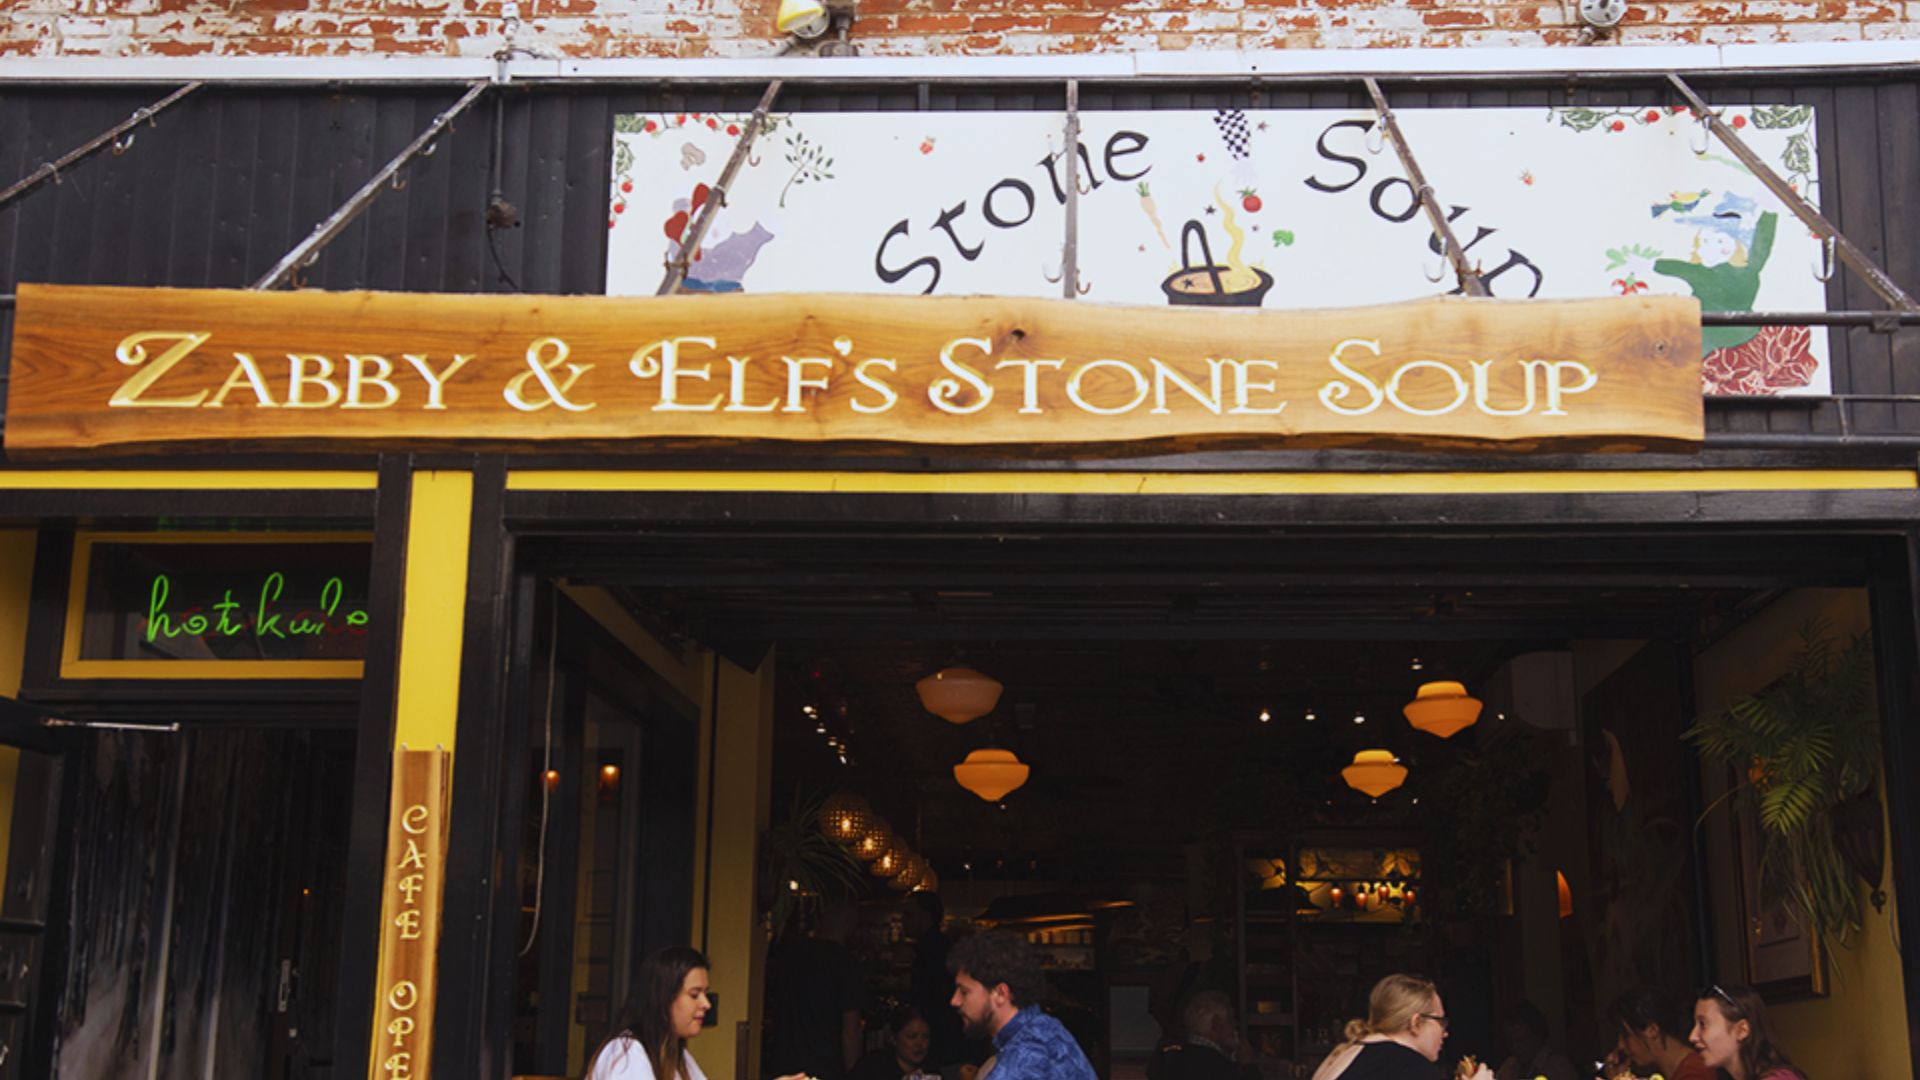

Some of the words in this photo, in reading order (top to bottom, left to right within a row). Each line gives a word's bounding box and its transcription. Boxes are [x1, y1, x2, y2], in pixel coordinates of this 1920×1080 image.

[875, 130, 1152, 295] Stone
[503, 338, 597, 411] &
[146, 574, 242, 643] hot
[395, 804, 429, 940] CAFE
